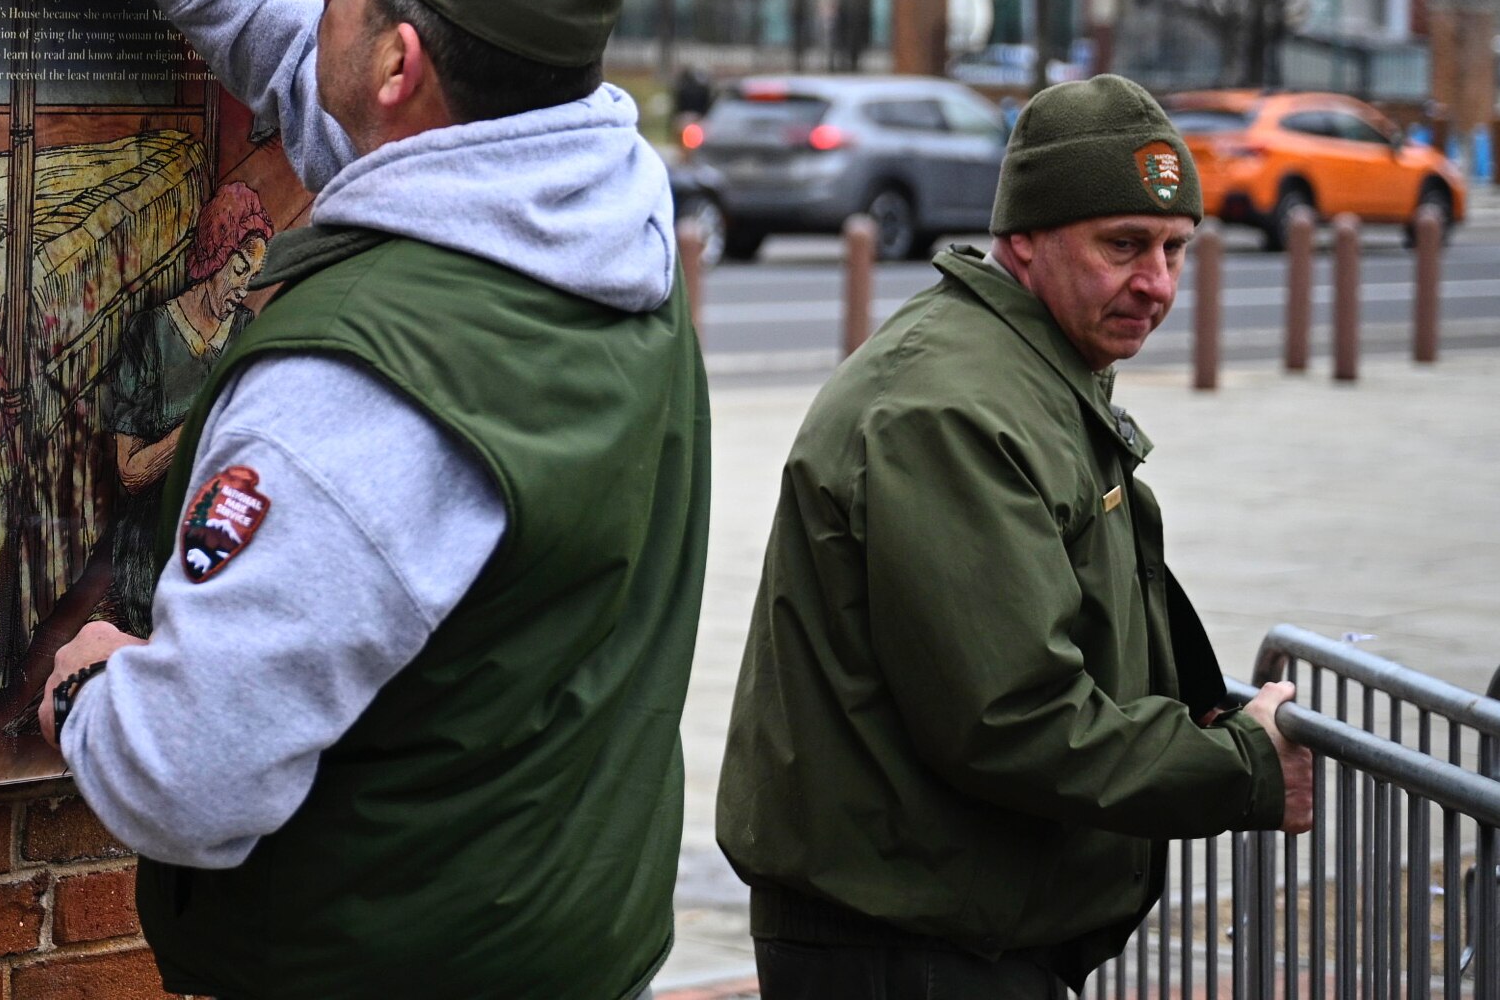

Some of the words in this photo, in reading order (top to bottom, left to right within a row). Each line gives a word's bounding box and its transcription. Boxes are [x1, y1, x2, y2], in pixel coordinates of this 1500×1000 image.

[9, 6, 41, 19] House
[43, 7, 81, 20] because
[83, 7, 100, 20] she
[102, 8, 150, 21] overheard
[19, 27, 31, 40] of
[33, 28, 65, 43] giving
[67, 28, 84, 40] the
[86, 31, 115, 44] young
[118, 32, 152, 41] woman
[154, 30, 165, 41] to
[166, 29, 183, 41] her
[3, 47, 28, 60] learn
[31, 49, 41, 60] to
[43, 48, 65, 61] read
[67, 48, 86, 61] and
[88, 48, 113, 61] know
[116, 49, 144, 61] about
[5, 68, 47, 81] received
[49, 68, 66, 81] the
[67, 68, 91, 81] least
[92, 68, 126, 81] mental
[128, 71, 140, 81] or
[141, 69, 169, 81] moral
[171, 69, 218, 81] instructio
